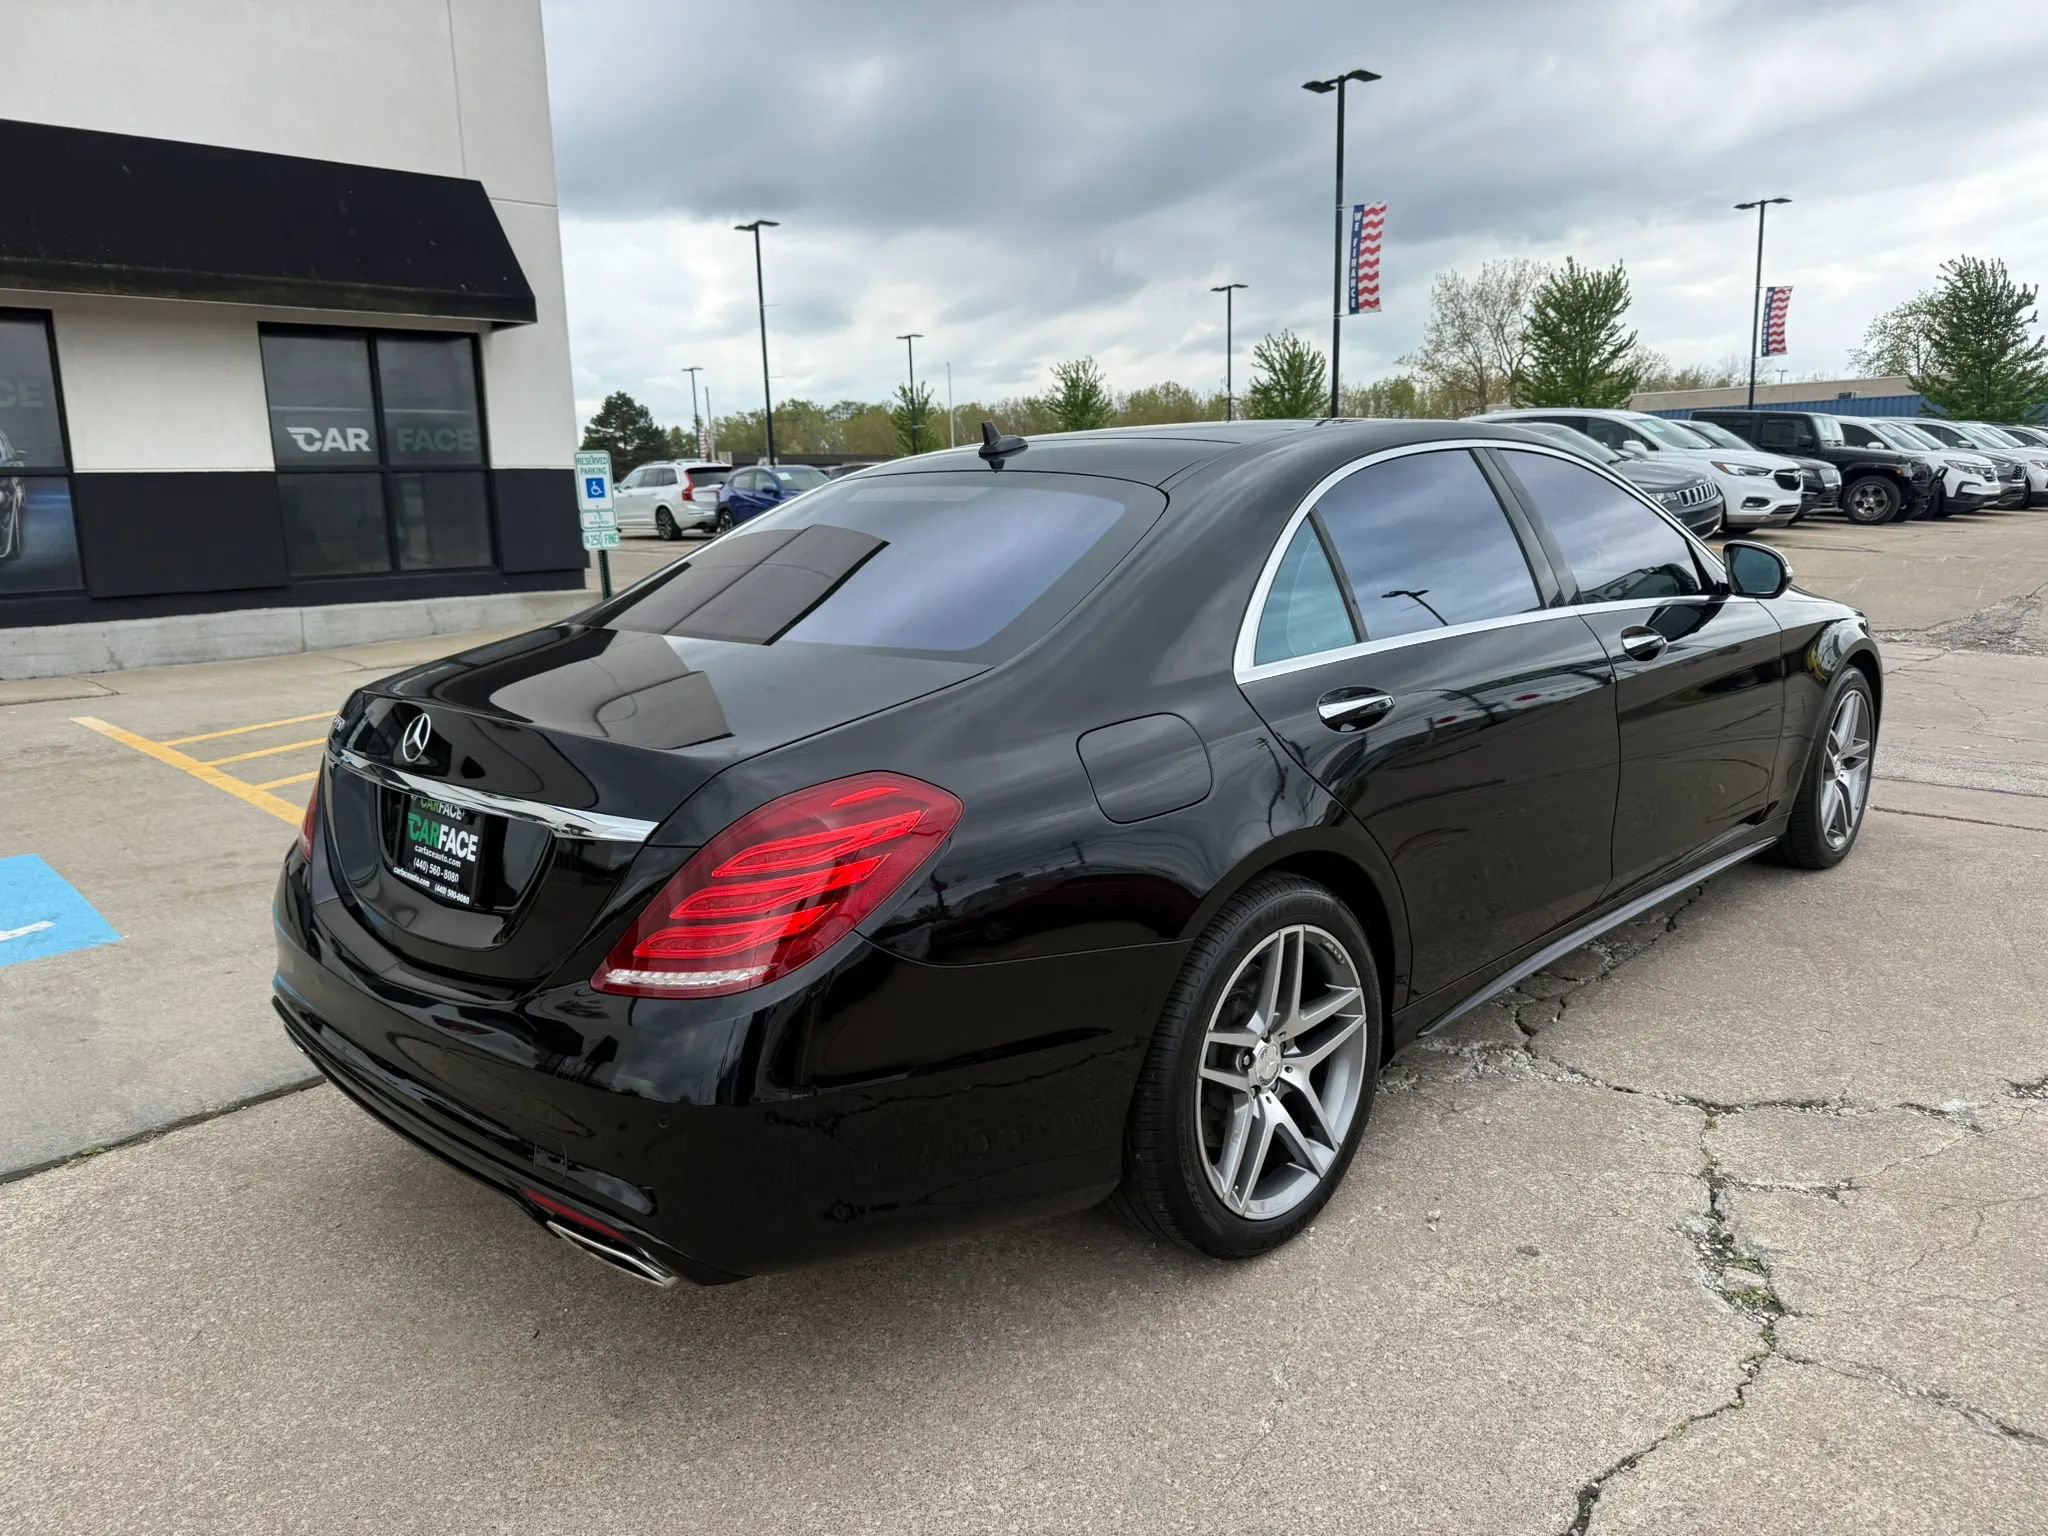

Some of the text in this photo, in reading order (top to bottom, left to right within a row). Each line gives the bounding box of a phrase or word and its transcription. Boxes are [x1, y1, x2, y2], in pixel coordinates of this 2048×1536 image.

[286, 427, 475, 452] CAR FACE
[576, 456, 608, 465] RESERVED
[580, 467, 607, 475] PARKING
[408, 813, 479, 862] CARFACE
[413, 857, 429, 874] (440)
[414, 844, 462, 868] carfaceauto.com
